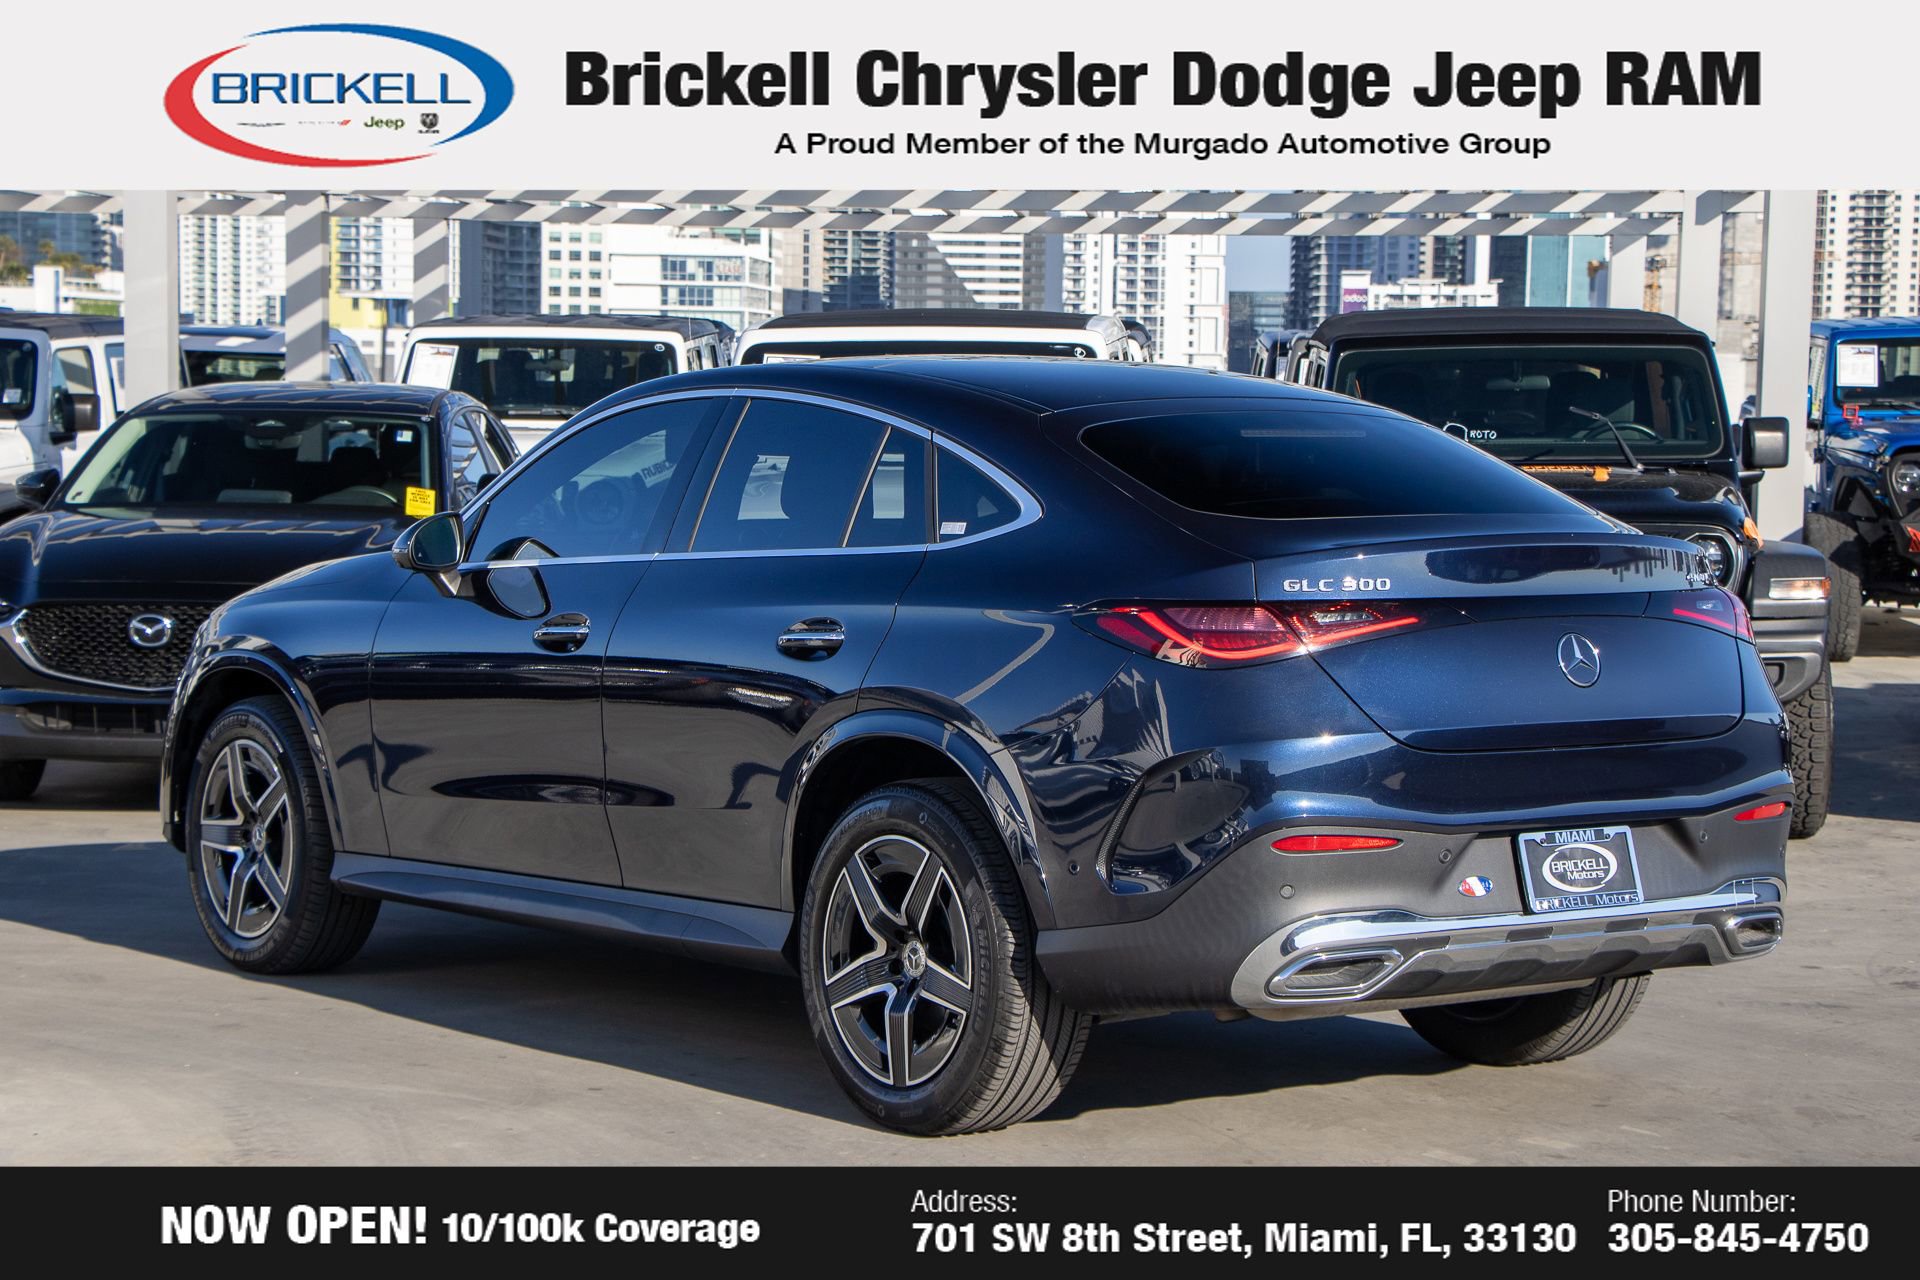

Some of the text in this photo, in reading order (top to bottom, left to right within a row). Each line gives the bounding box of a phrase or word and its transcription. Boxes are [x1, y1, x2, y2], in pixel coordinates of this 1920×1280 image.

[1283, 577, 1391, 592] GLC 300
[1555, 830, 1597, 844] MIAMI
[1551, 857, 1609, 873] BRICKELL
[1567, 869, 1605, 880] Motors
[1535, 891, 1639, 911] BRICKELL Motors
